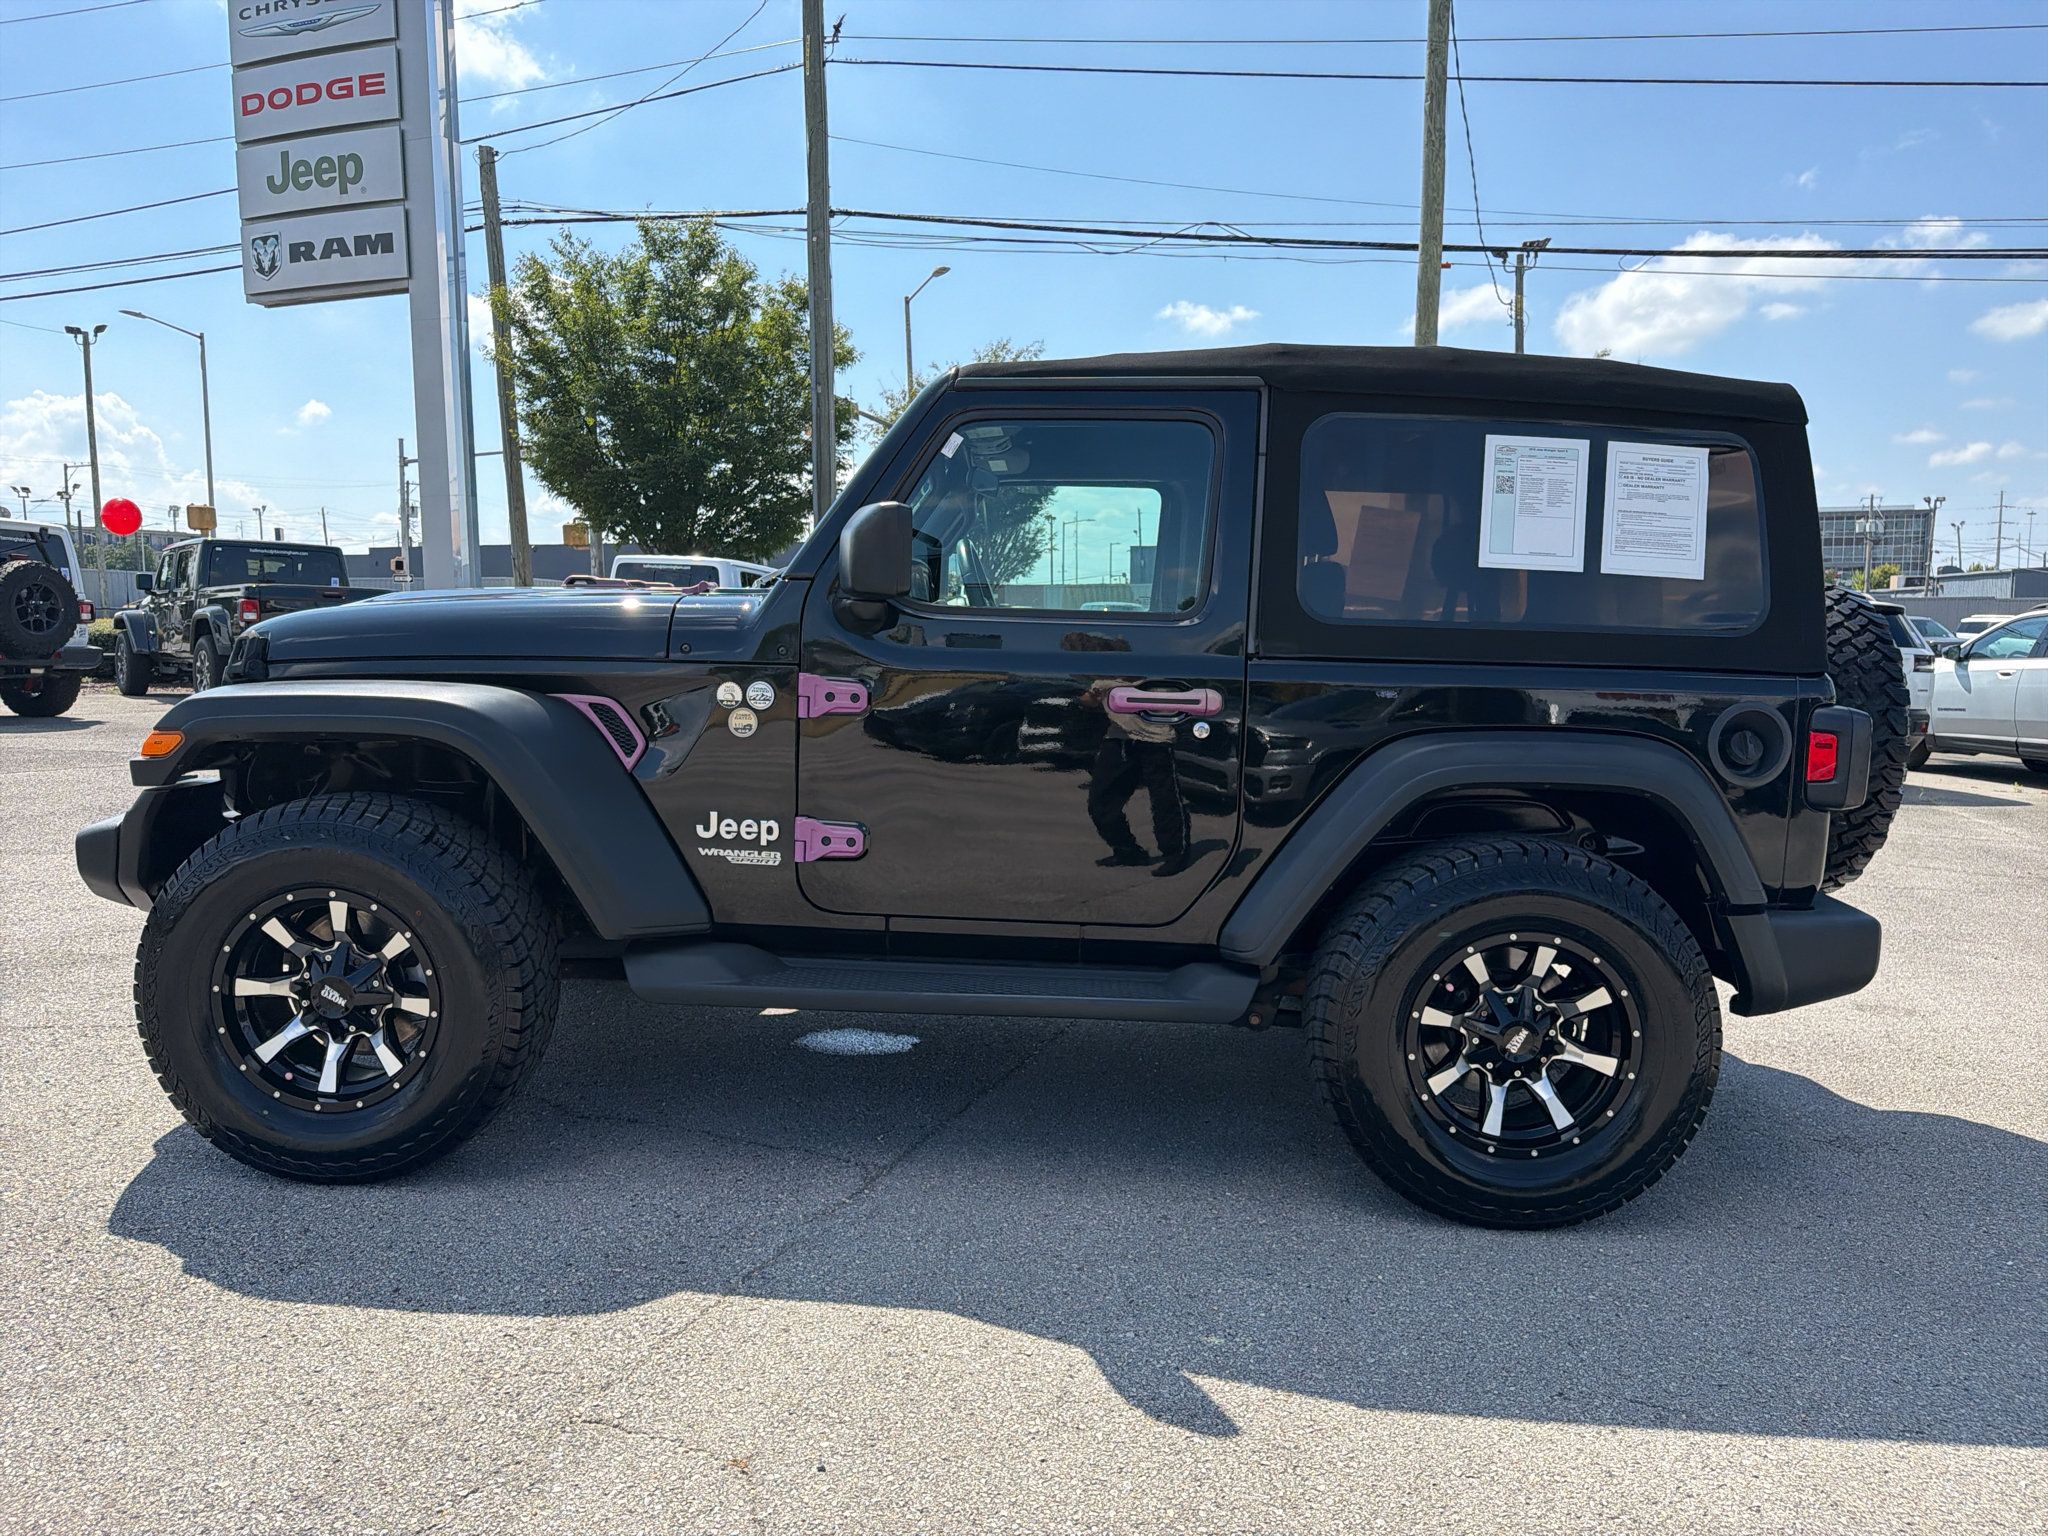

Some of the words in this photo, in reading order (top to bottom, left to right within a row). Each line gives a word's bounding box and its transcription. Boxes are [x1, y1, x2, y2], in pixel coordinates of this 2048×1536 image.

[240, 72, 387, 117] DODGE
[266, 150, 364, 195] Jeep
[288, 232, 395, 264] RAM
[695, 811, 780, 846] Jeep
[697, 847, 782, 860] WRANGLER
[730, 857, 779, 865] SPORT
